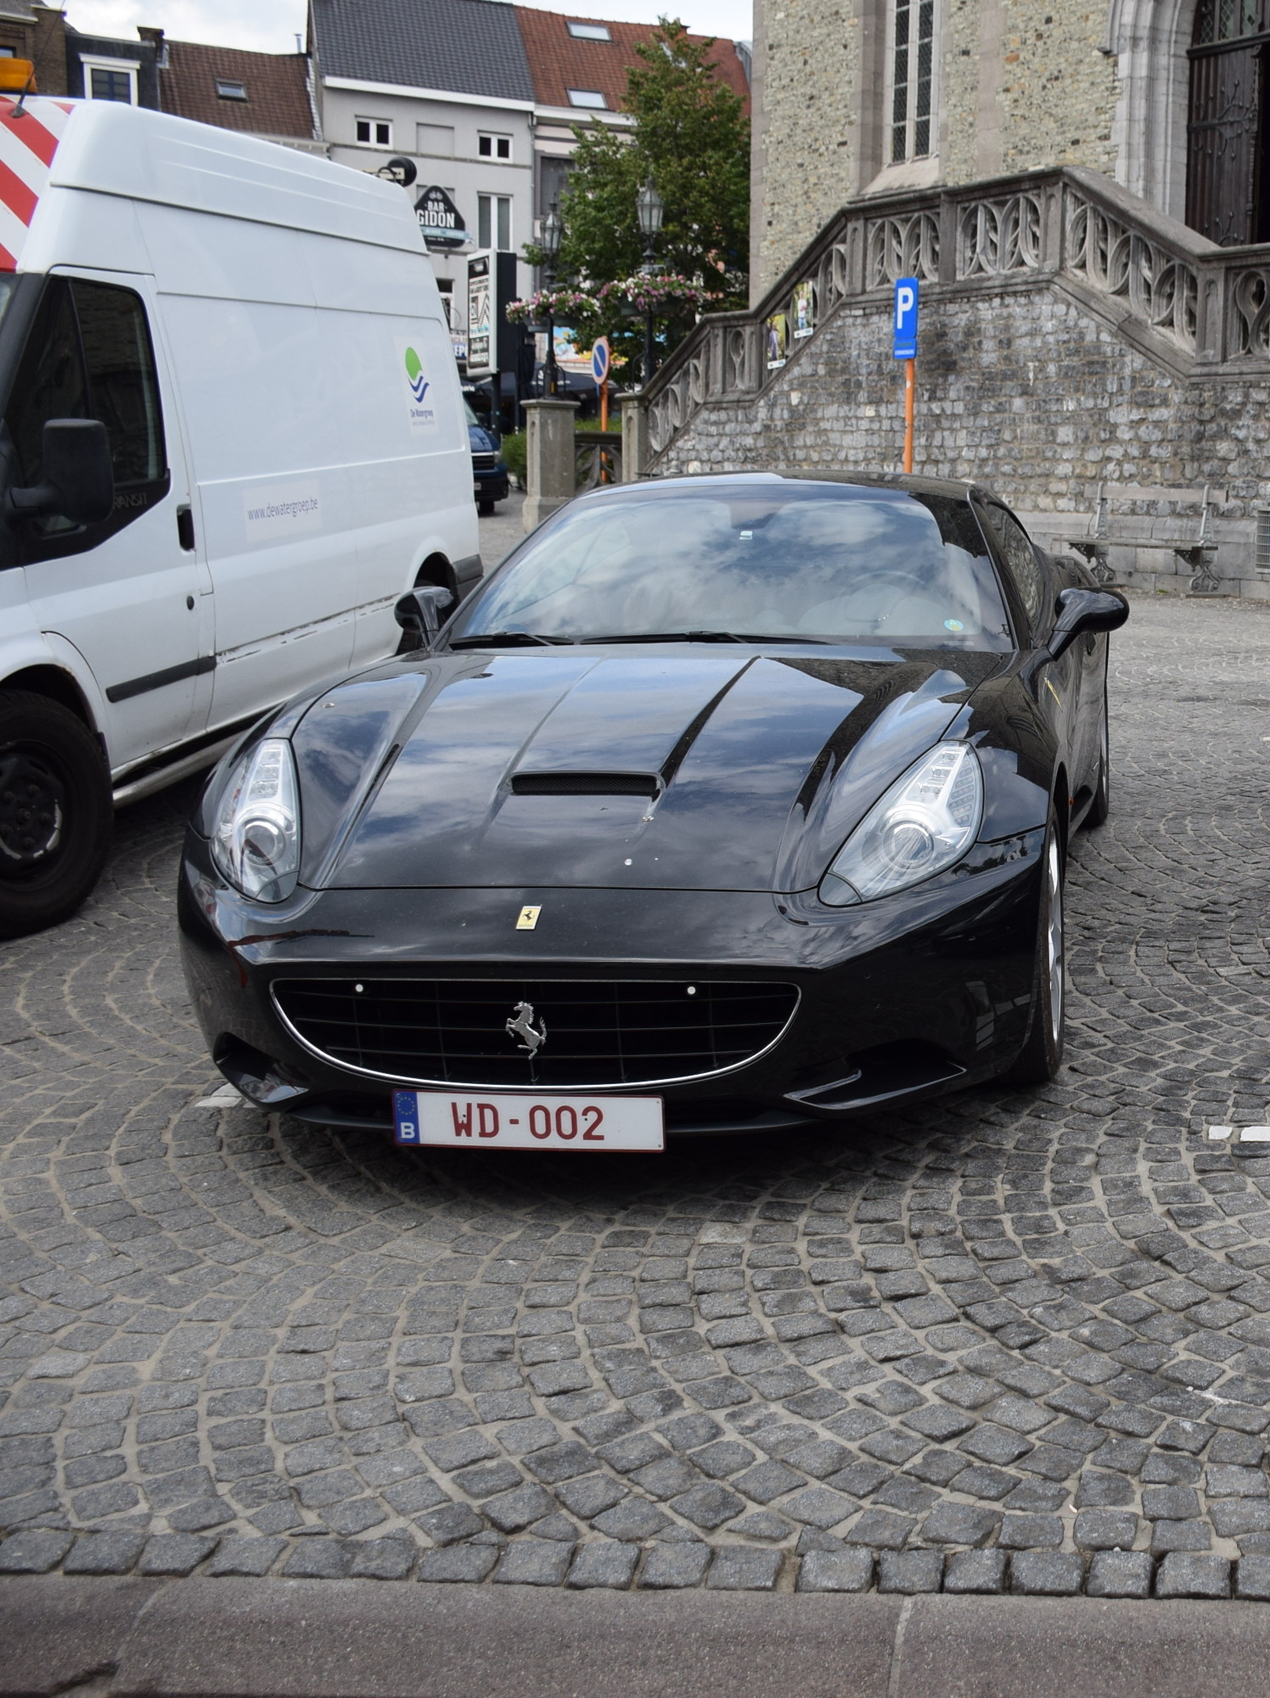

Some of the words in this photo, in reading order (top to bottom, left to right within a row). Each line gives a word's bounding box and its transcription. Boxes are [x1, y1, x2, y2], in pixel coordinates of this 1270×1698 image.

[427, 200, 445, 212] BAR
[416, 209, 455, 228] GIDON
[897, 286, 914, 330] P
[247, 496, 319, 521] www.dewatergroep.be
[400, 1122, 416, 1139] B
